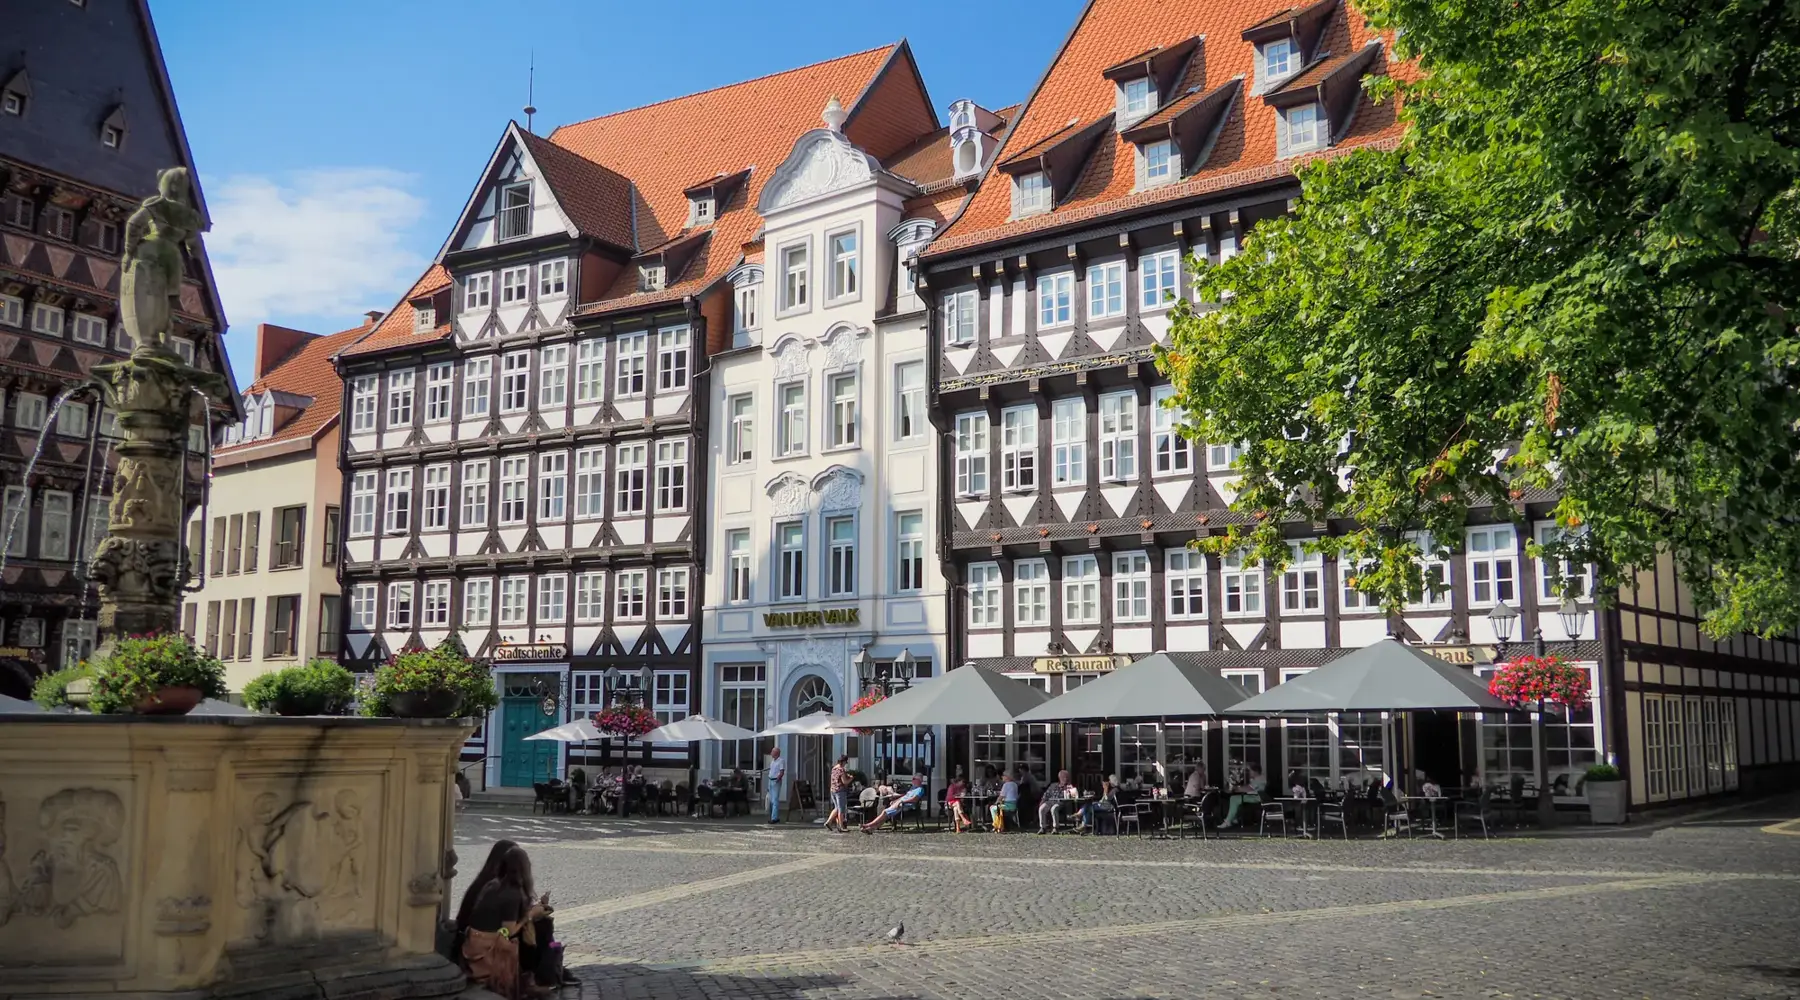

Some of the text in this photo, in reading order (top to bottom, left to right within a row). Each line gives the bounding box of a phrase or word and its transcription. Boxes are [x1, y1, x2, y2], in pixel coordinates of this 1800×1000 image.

[763, 608, 860, 627] VAN DER VALK
[498, 645, 561, 660] Stadtschenke
[1046, 659, 1117, 671] Restaurant
